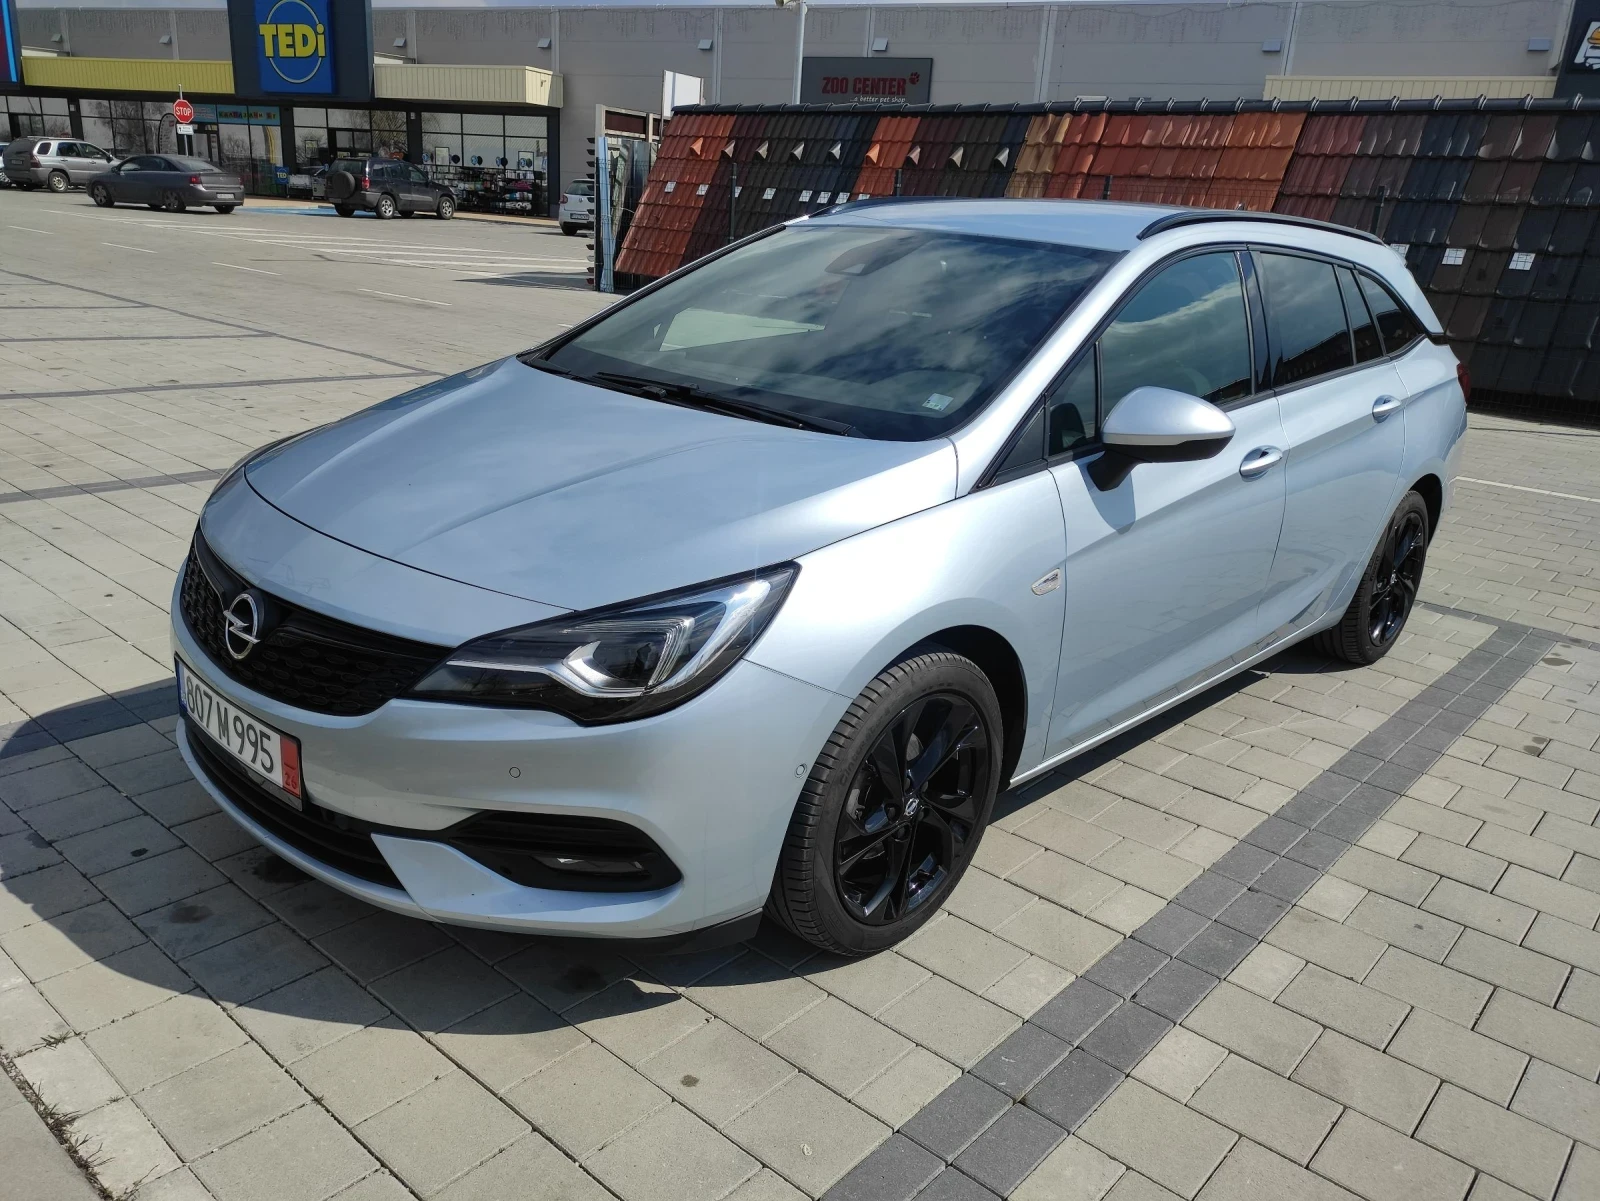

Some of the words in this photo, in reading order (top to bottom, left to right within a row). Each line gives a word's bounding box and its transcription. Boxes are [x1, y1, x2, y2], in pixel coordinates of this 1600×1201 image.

[259, 23, 326, 58] TEDi
[821, 76, 849, 95] ZOO
[852, 77, 907, 96] CENTER
[859, 95, 879, 103] better
[879, 96, 890, 104] pet
[890, 96, 906, 105] shop
[175, 105, 192, 117] STOP
[186, 675, 213, 728] 807
[233, 715, 274, 774] 995
[284, 772, 297, 790] 26
